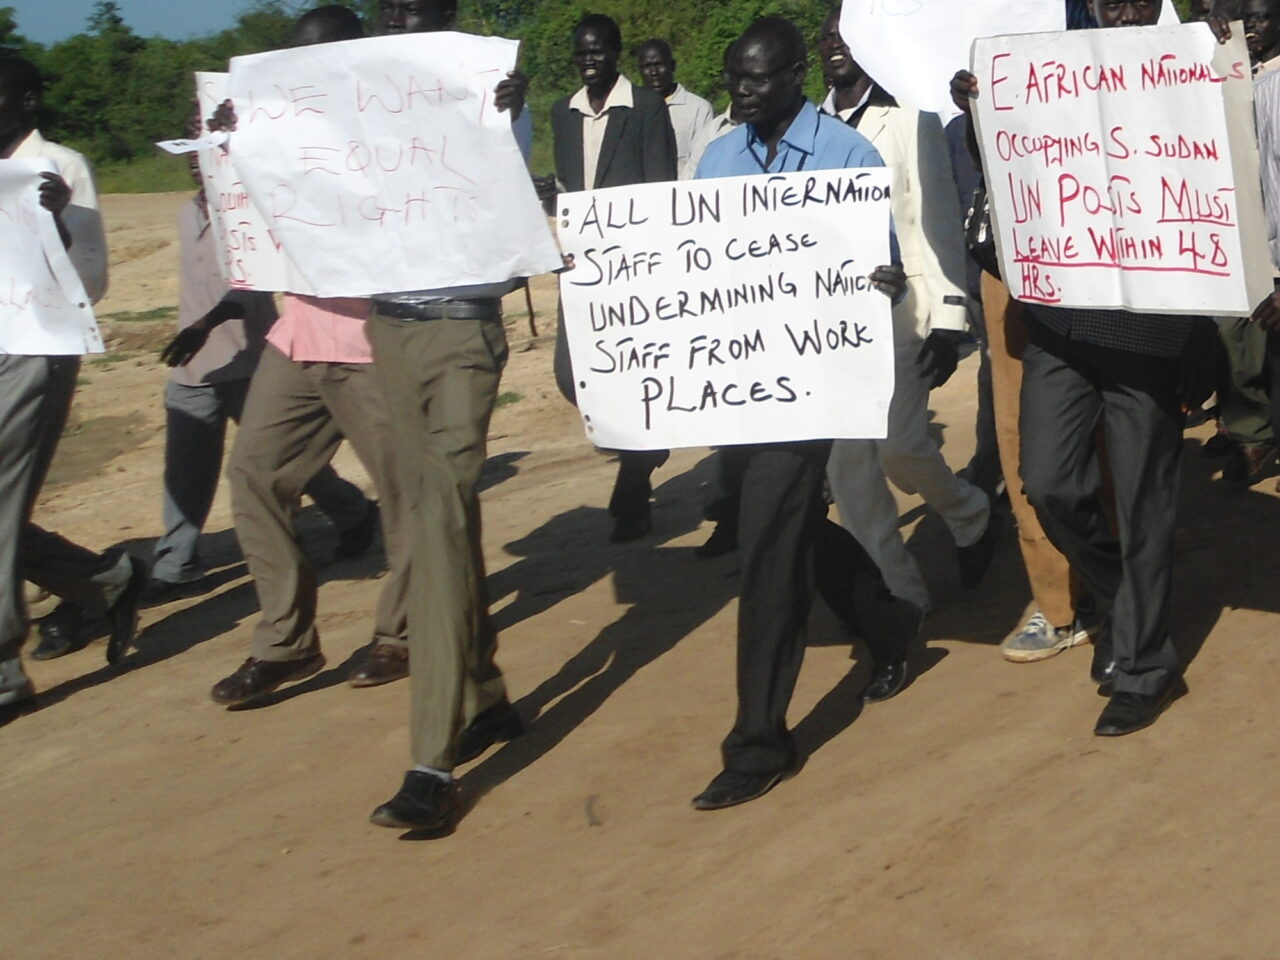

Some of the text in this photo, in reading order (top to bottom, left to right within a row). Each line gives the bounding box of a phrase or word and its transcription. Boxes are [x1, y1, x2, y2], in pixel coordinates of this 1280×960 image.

[249, 84, 328, 124] WE
[357, 63, 500, 127] WANT
[1025, 60, 1125, 104] AFRICAN
[299, 135, 477, 186] EQUAL
[996, 129, 1100, 168] OCCUPYING
[1144, 134, 1219, 161] SUDAN
[579, 195, 649, 239] ALL
[671, 186, 721, 227] UN
[1008, 172, 1237, 227] UN POSTS MUST
[569, 233, 818, 287] STAFF TO CEASE
[1013, 227, 1230, 270] LEAVE WITHIN 48
[588, 271, 797, 333] UNDERMINING
[590, 319, 874, 374] STAFF FROM WORK
[641, 376, 812, 431] PLACES.
